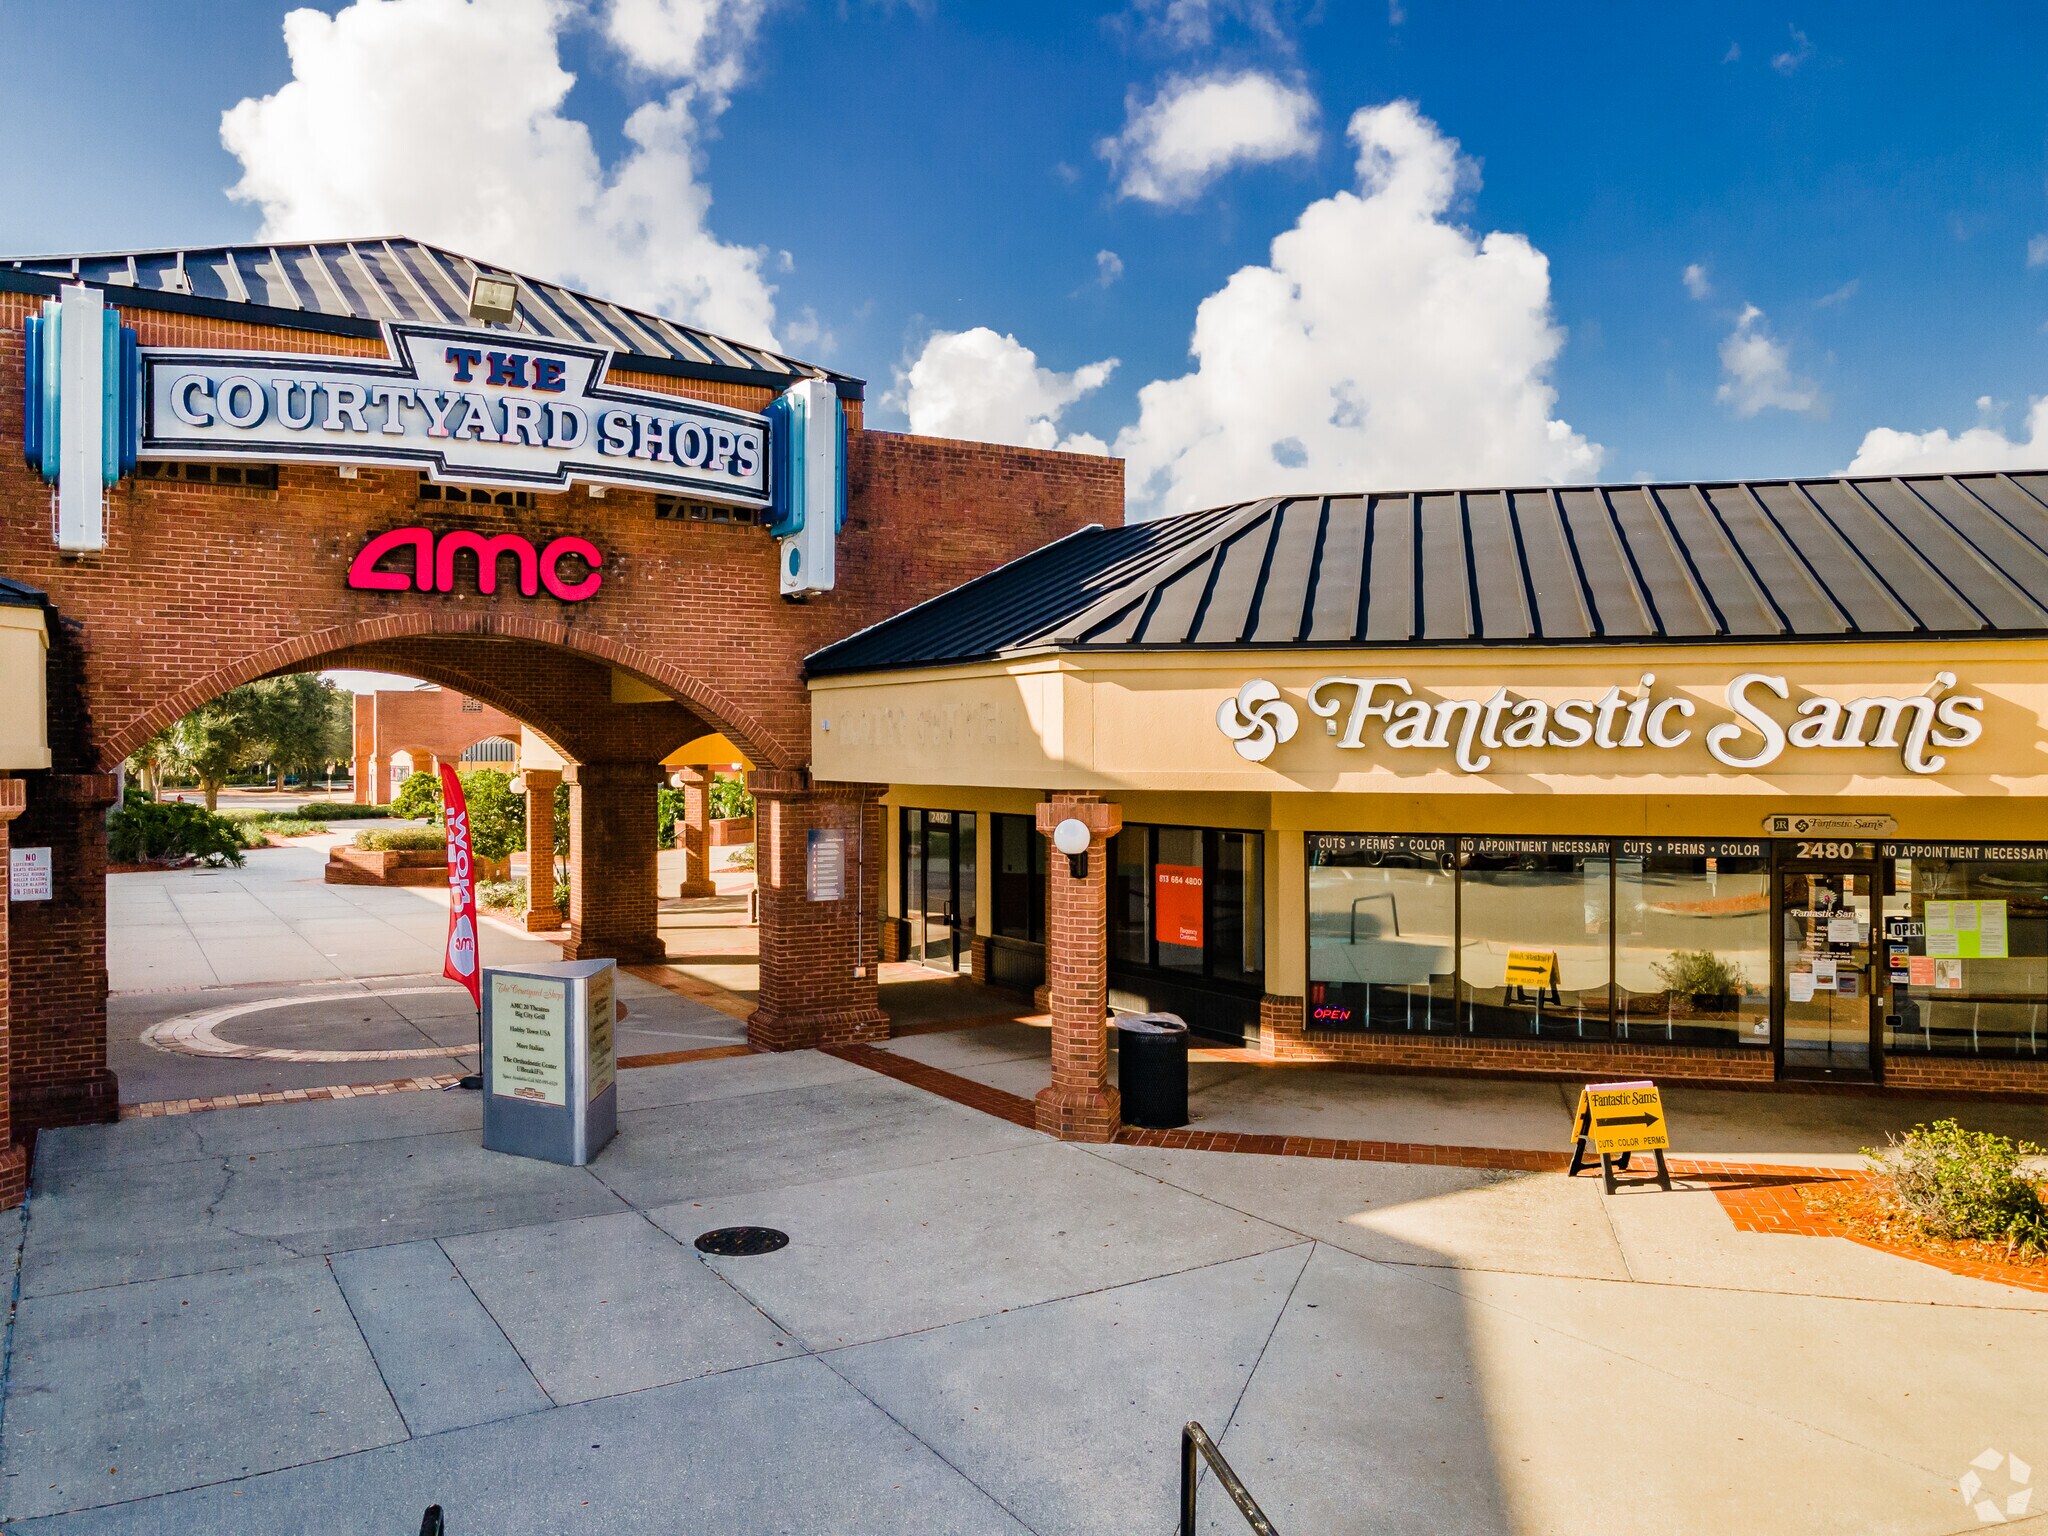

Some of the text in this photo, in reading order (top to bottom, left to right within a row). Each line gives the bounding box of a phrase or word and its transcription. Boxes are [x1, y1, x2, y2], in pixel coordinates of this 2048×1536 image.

[445, 347, 566, 393] THE
[170, 374, 760, 477] COURTYARD SHOPS
[1307, 670, 1985, 774] Fantastic Sam's
[931, 812, 949, 824] 2482
[1808, 818, 1852, 830] Fantastic
[1318, 837, 1445, 851] CUTS PERMS COLOR
[1460, 840, 1610, 853] NO APPOINTMENT NECESSARY
[1623, 842, 1760, 856] CUTS PERMS COLOR
[1796, 841, 1854, 859] 2480
[25, 853, 37, 862] NO
[1882, 844, 2048, 860] NO APPOINTMENT NECESSARY
[1790, 908, 1834, 918] Fantastic
[1894, 923, 1924, 936] OPEN
[1314, 1009, 1351, 1020] OPEN
[540, 1029, 551, 1037] USA
[503, 1055, 512, 1063] The
[1590, 1091, 1658, 1107] Fantastic Sams
[1598, 1136, 1666, 1149] CUTS COLOR PERMS
